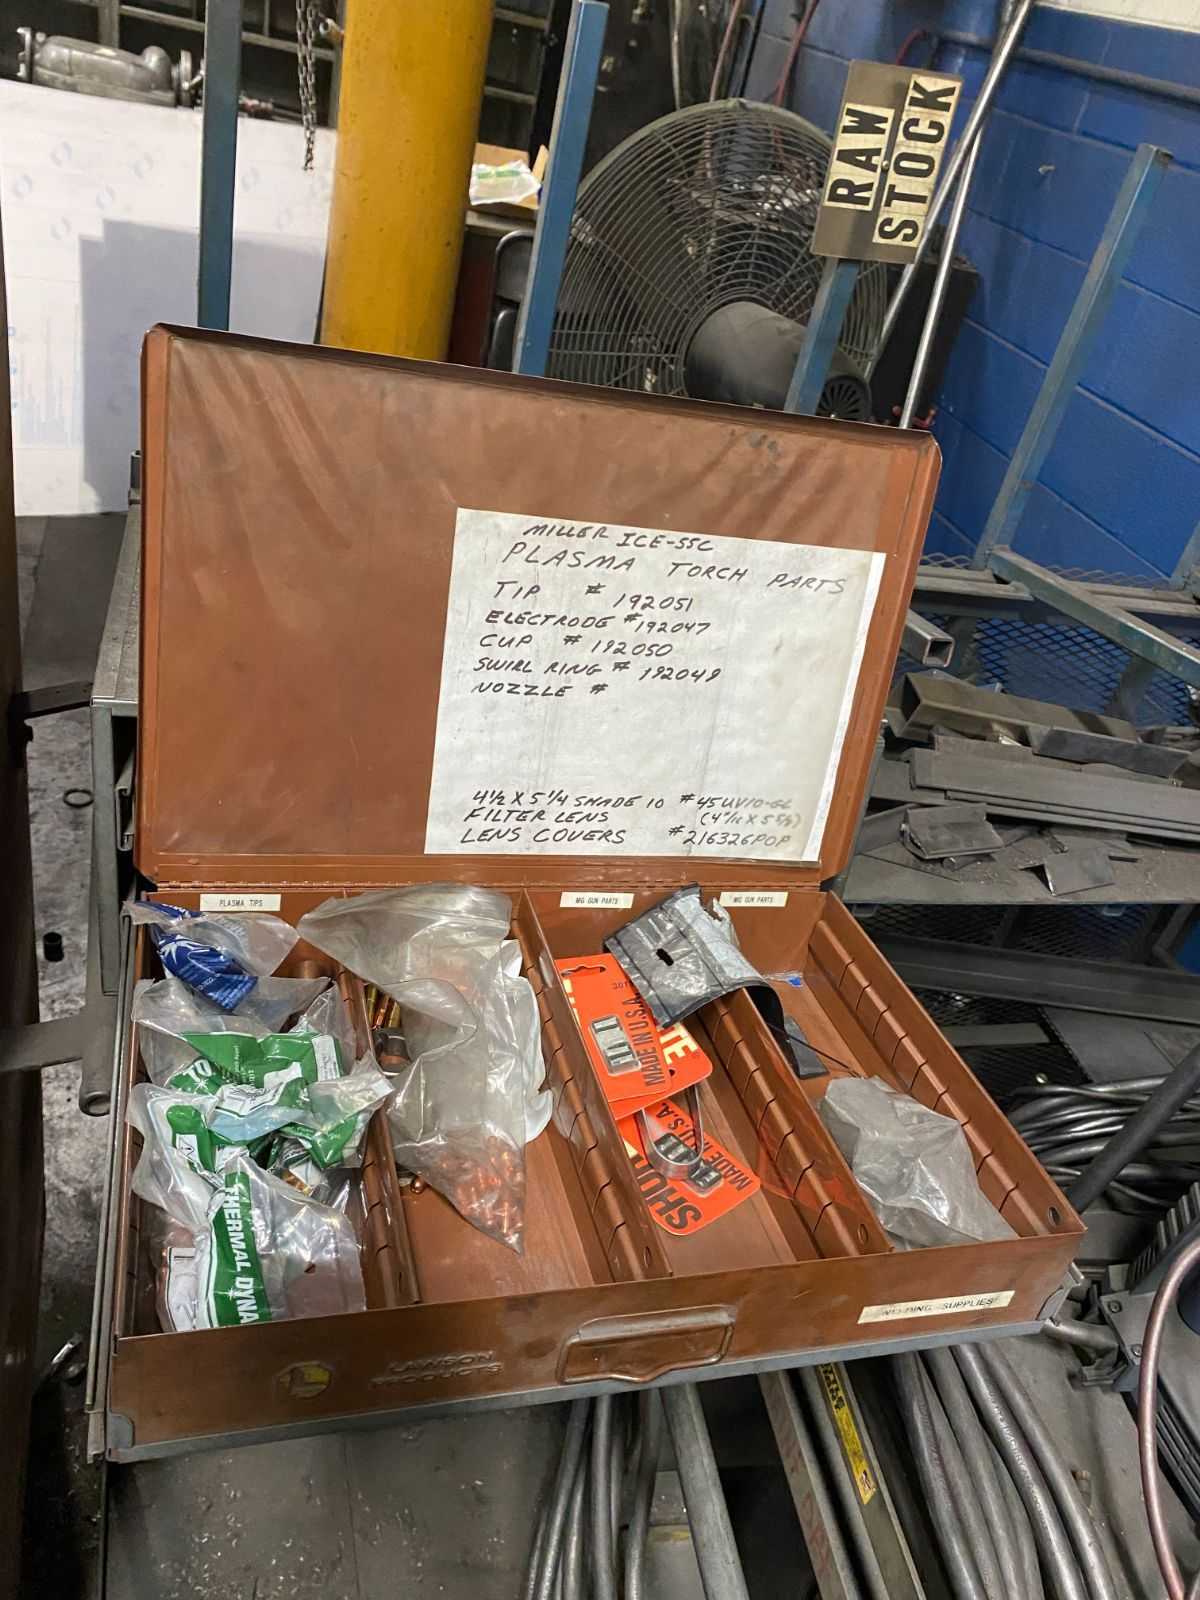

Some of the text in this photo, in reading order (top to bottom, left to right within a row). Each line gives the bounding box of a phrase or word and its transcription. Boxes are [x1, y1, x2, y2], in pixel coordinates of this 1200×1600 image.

[828, 107, 889, 207] RAW
[878, 80, 957, 243] STOCK
[523, 523, 609, 539] MILLER
[502, 541, 847, 595] PLASMA TORCH PARTS
[493, 580, 694, 612] TIP # 192051
[485, 610, 616, 629] ELECTRODE
[479, 634, 673, 657] CUP # 192050
[473, 657, 533, 673] SWIRL
[543, 662, 602, 676] RING
[612, 661, 630, 673] #
[470, 682, 608, 697] NOZZLE #
[511, 791, 524, 806] X
[573, 795, 642, 808] SHADE
[646, 798, 664, 809] 10
[463, 807, 546, 822] FILTER
[554, 811, 609, 824] LENS
[460, 828, 522, 843] LENS
[532, 828, 627, 844] COVERS
[219, 899, 264, 907] PLASMA TIPS
[631, 1030, 656, 1047] IN
[637, 1043, 666, 1086] MADE
[708, 1151, 752, 1191] MADE
[222, 1185, 250, 1272] THERMAL
[941, 1297, 995, 1311] SUPPLIES
